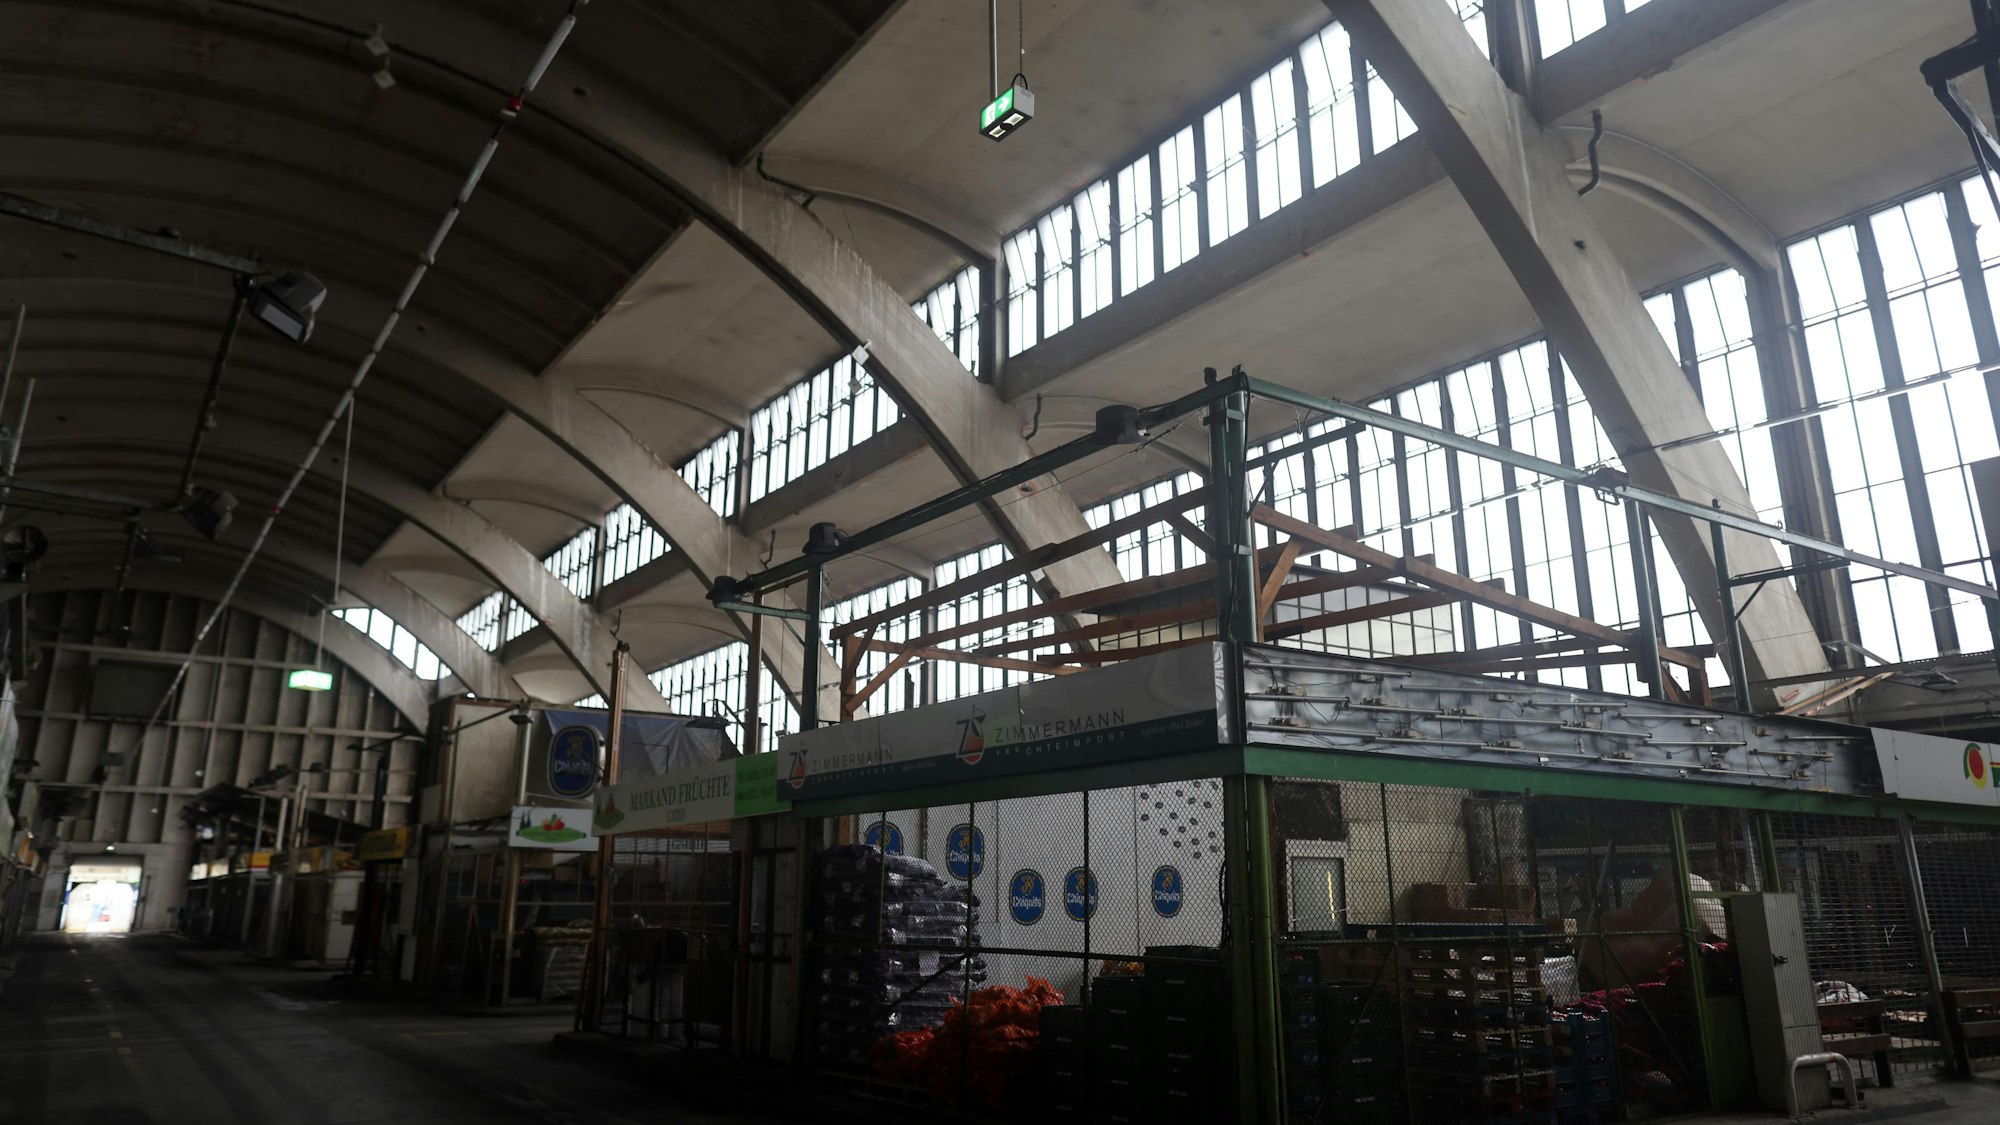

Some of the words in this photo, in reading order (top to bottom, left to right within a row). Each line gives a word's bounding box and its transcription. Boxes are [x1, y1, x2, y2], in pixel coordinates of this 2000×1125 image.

[995, 709, 1124, 743] ZIMMERMANN
[812, 748, 893, 772] ZIMMERMANN
[630, 786, 675, 812] MARKAND
[678, 774, 730, 804] FRÜCHTE
